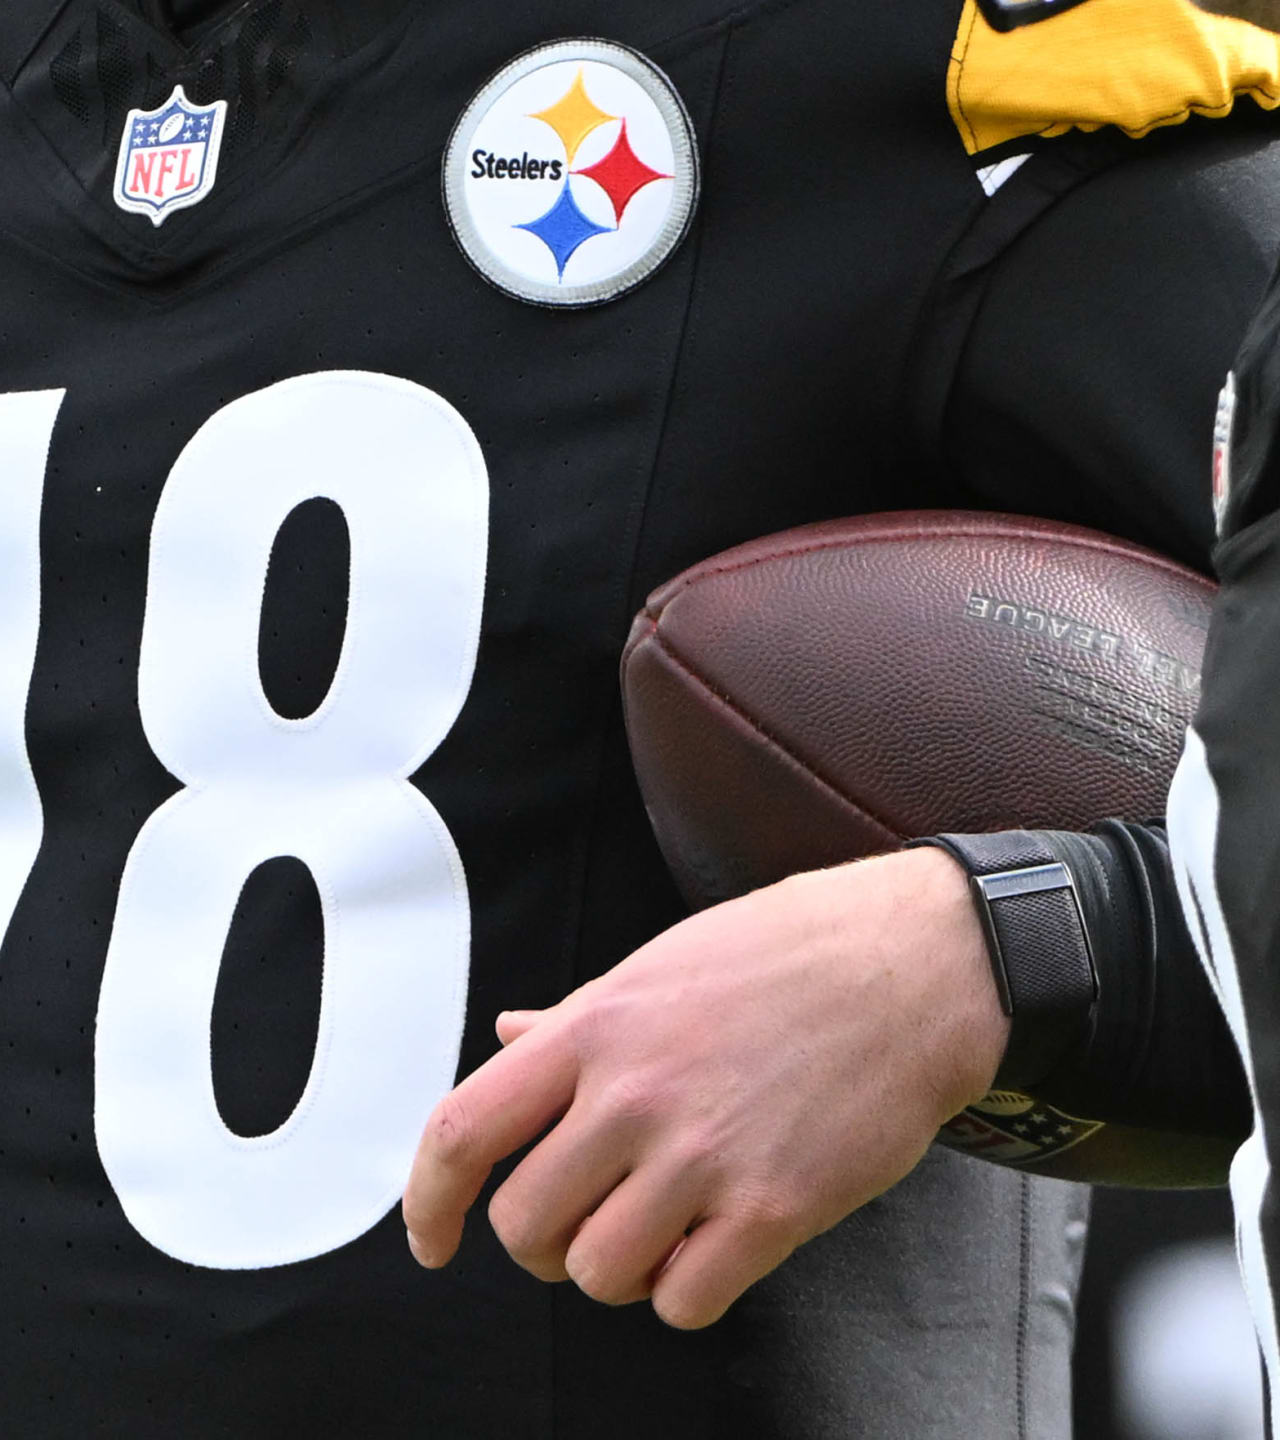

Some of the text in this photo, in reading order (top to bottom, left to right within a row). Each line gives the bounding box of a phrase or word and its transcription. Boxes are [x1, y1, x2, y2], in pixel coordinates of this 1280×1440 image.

[129, 148, 195, 198] NFL
[470, 148, 563, 182] Steelers
[968, 596, 1121, 659] LEAGUE
